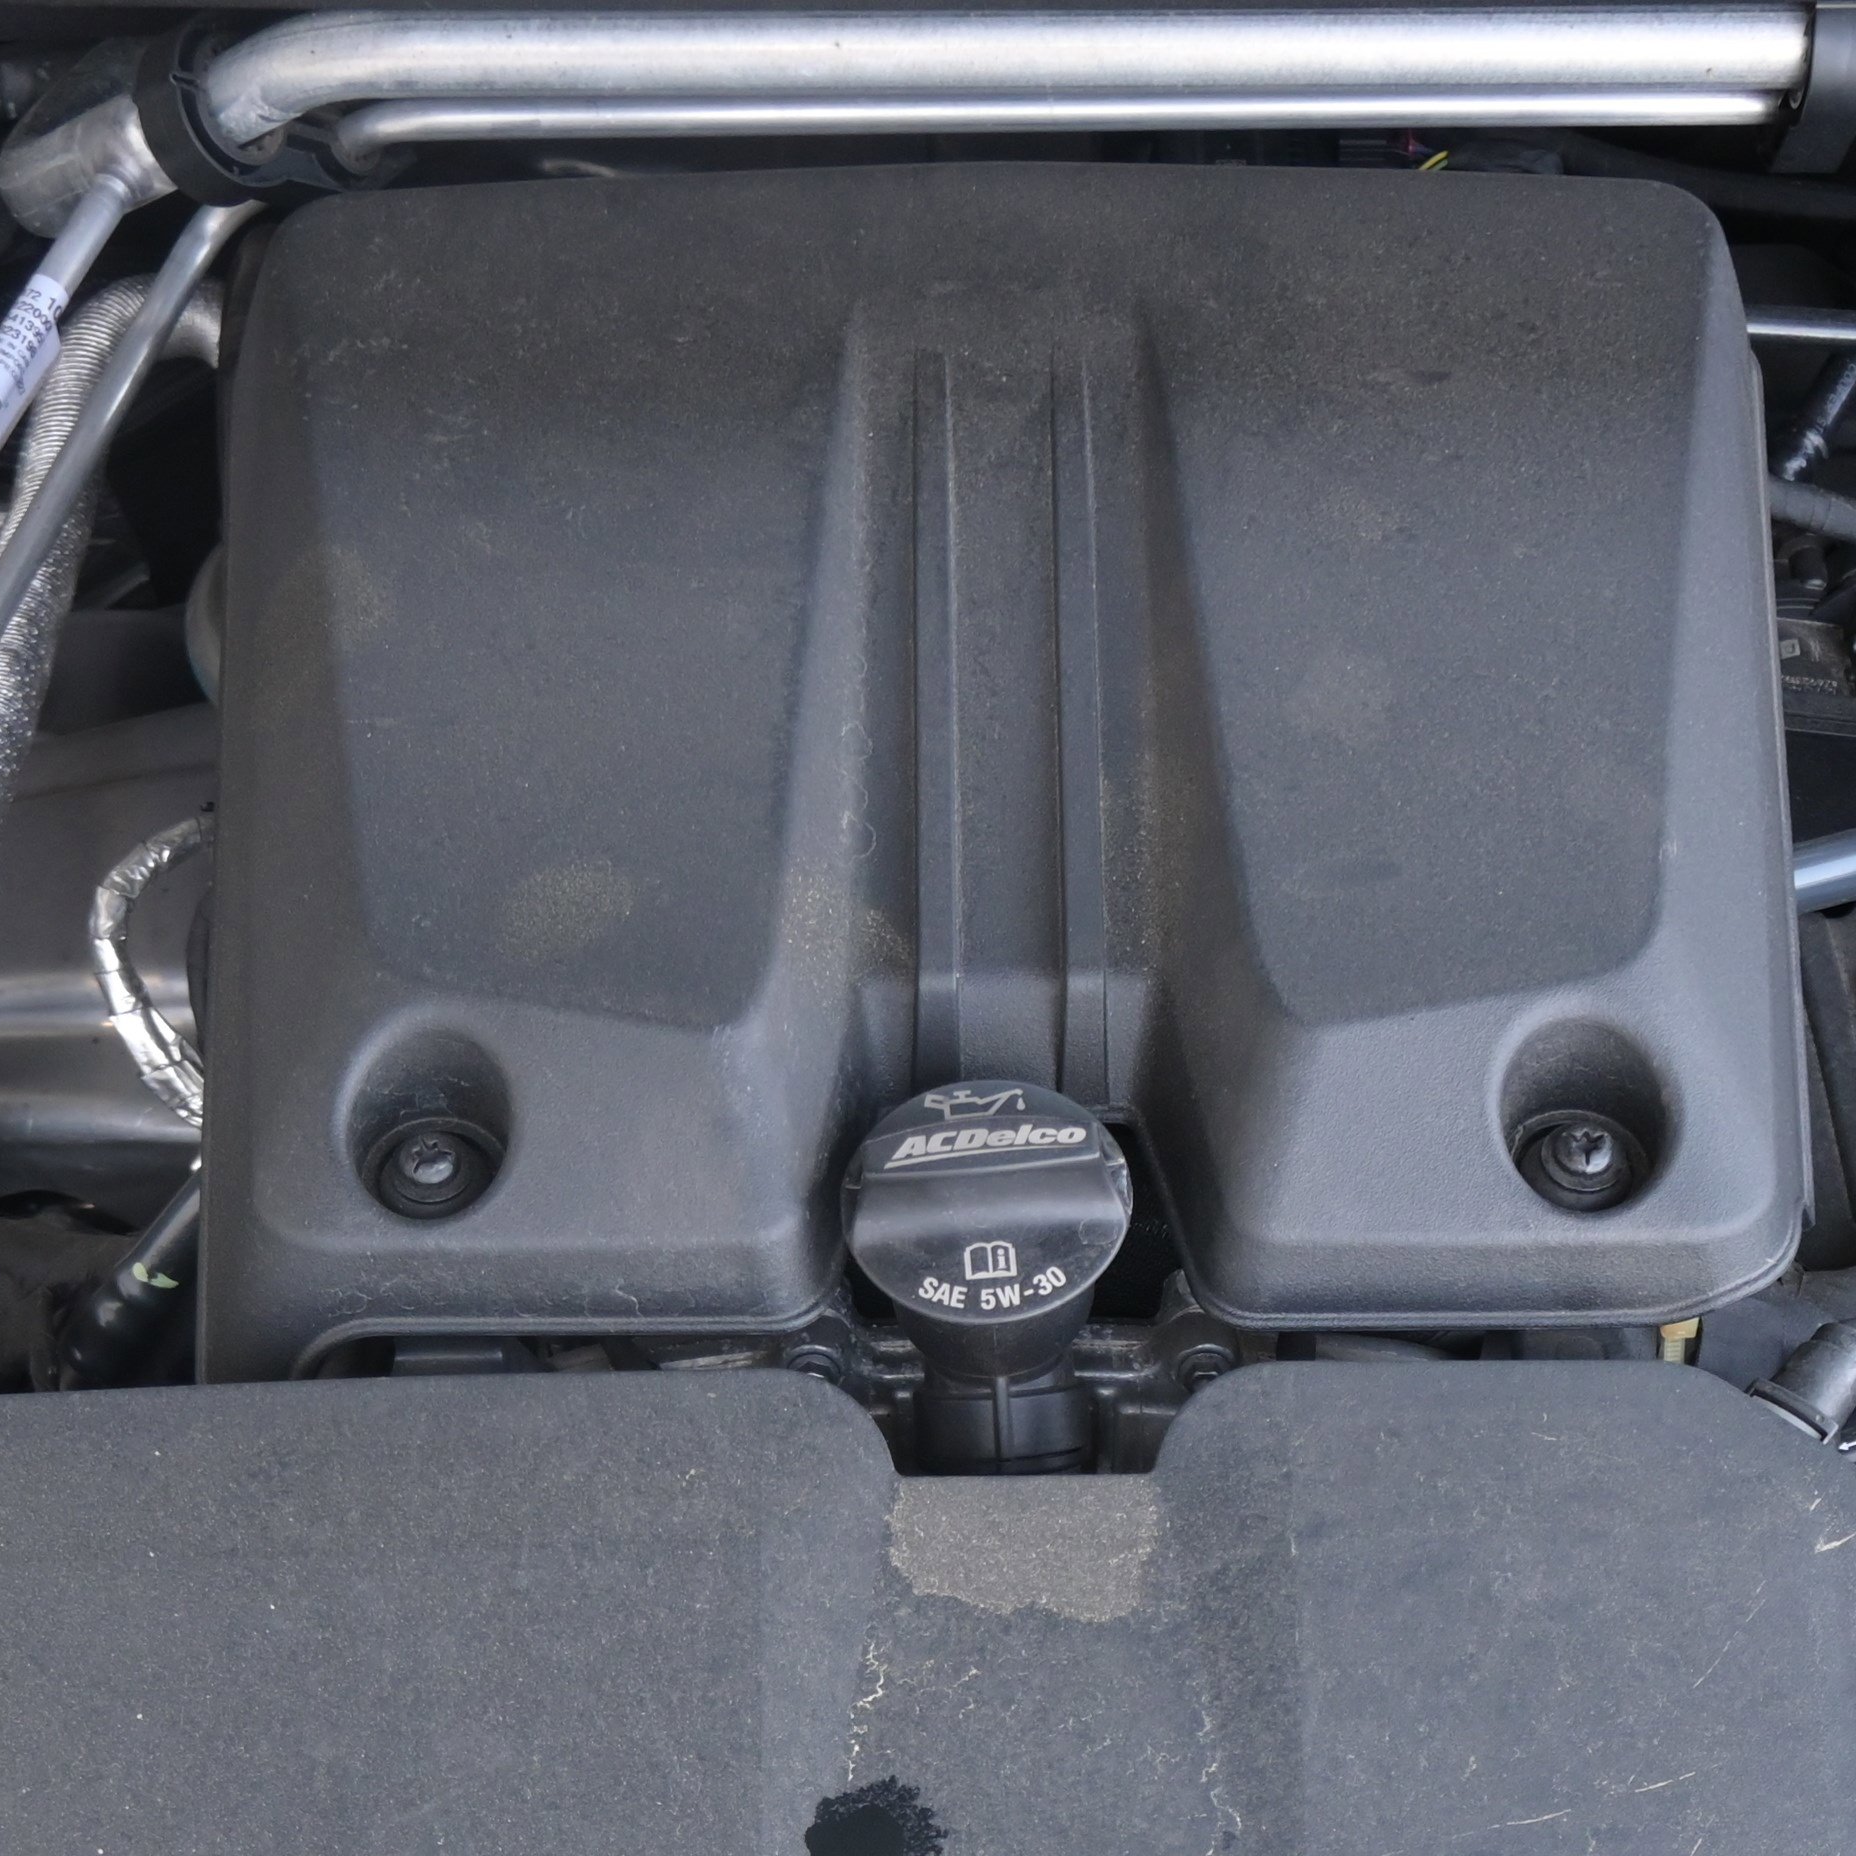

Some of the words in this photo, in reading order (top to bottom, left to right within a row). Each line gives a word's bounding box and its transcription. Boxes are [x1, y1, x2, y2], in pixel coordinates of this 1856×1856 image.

[48, 297, 62, 320] 10
[890, 1123, 1087, 1161] ACDelco
[918, 1276, 968, 1309] SAE
[980, 1266, 1067, 1310] 5W-30
